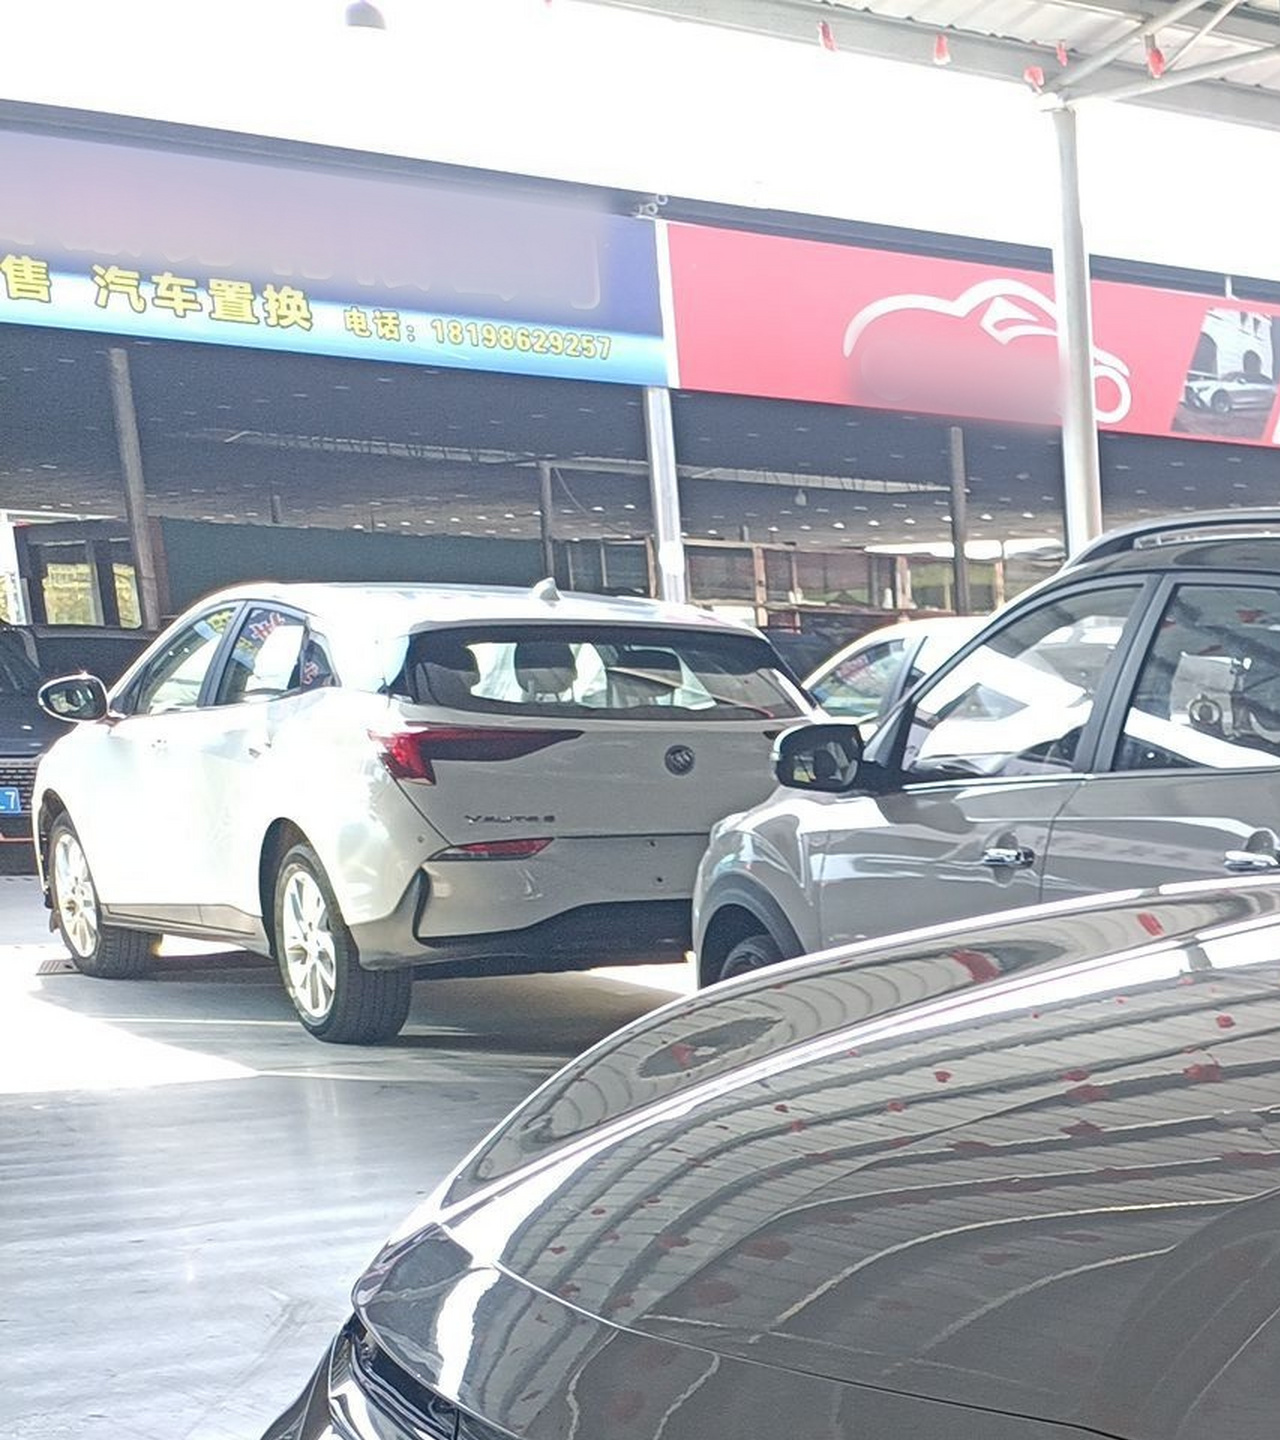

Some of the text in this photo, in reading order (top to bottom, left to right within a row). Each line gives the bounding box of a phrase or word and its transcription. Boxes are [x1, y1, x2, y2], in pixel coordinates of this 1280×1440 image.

[0, 254, 313, 331] 售 汽车置换
